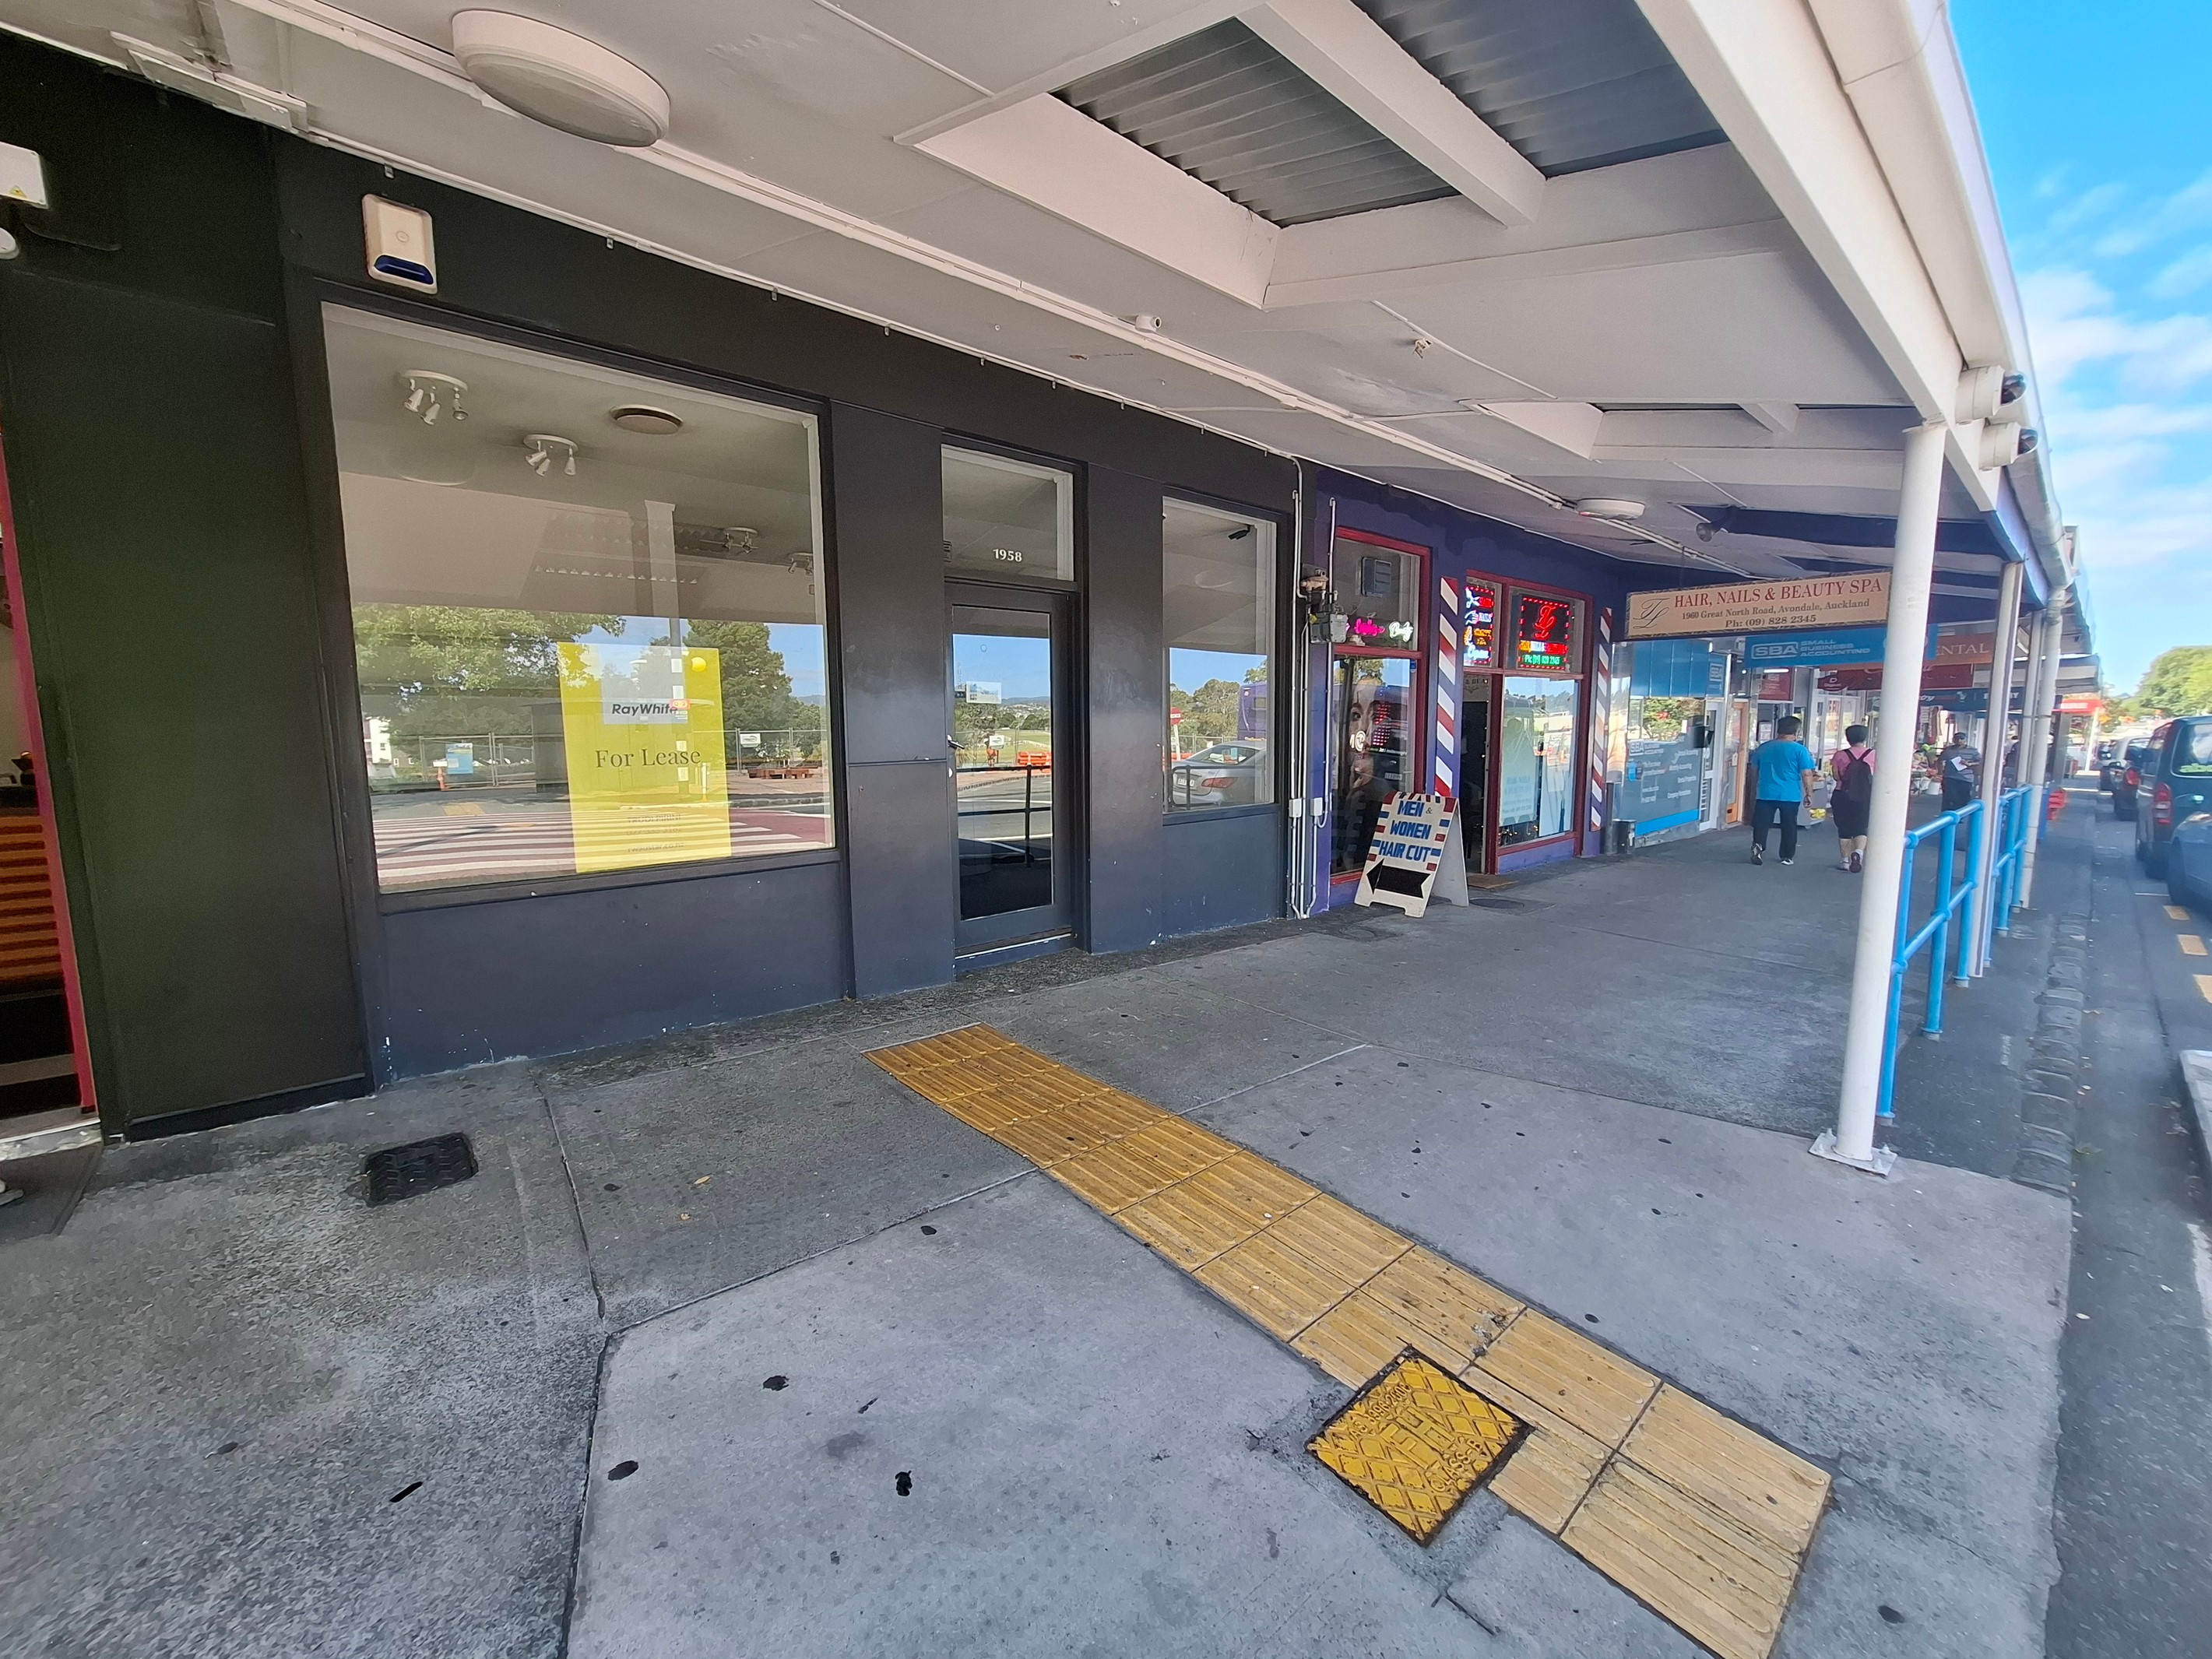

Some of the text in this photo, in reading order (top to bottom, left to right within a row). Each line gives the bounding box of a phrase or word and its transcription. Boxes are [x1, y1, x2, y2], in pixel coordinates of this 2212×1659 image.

[993, 548, 1022, 562] 1958
[1675, 578, 1882, 608] HAIR, NAILS & BEAUTY SPA
[1683, 599, 1870, 620] 1960 Great North Road, Avondale, Auckland
[1725, 620, 1743, 628] Ph:
[1746, 617, 1765, 627] (09)
[1768, 616, 1788, 625] 828
[1755, 645, 1798, 657] SBA
[1800, 644, 1854, 652] BUSINESS
[1800, 648, 1869, 657] ACCOUNTING
[595, 748, 702, 768] For Lease
[1397, 800, 1425, 817] MEN
[1390, 820, 1432, 839] WOMEN
[1378, 839, 1431, 863] HAIR CUT
